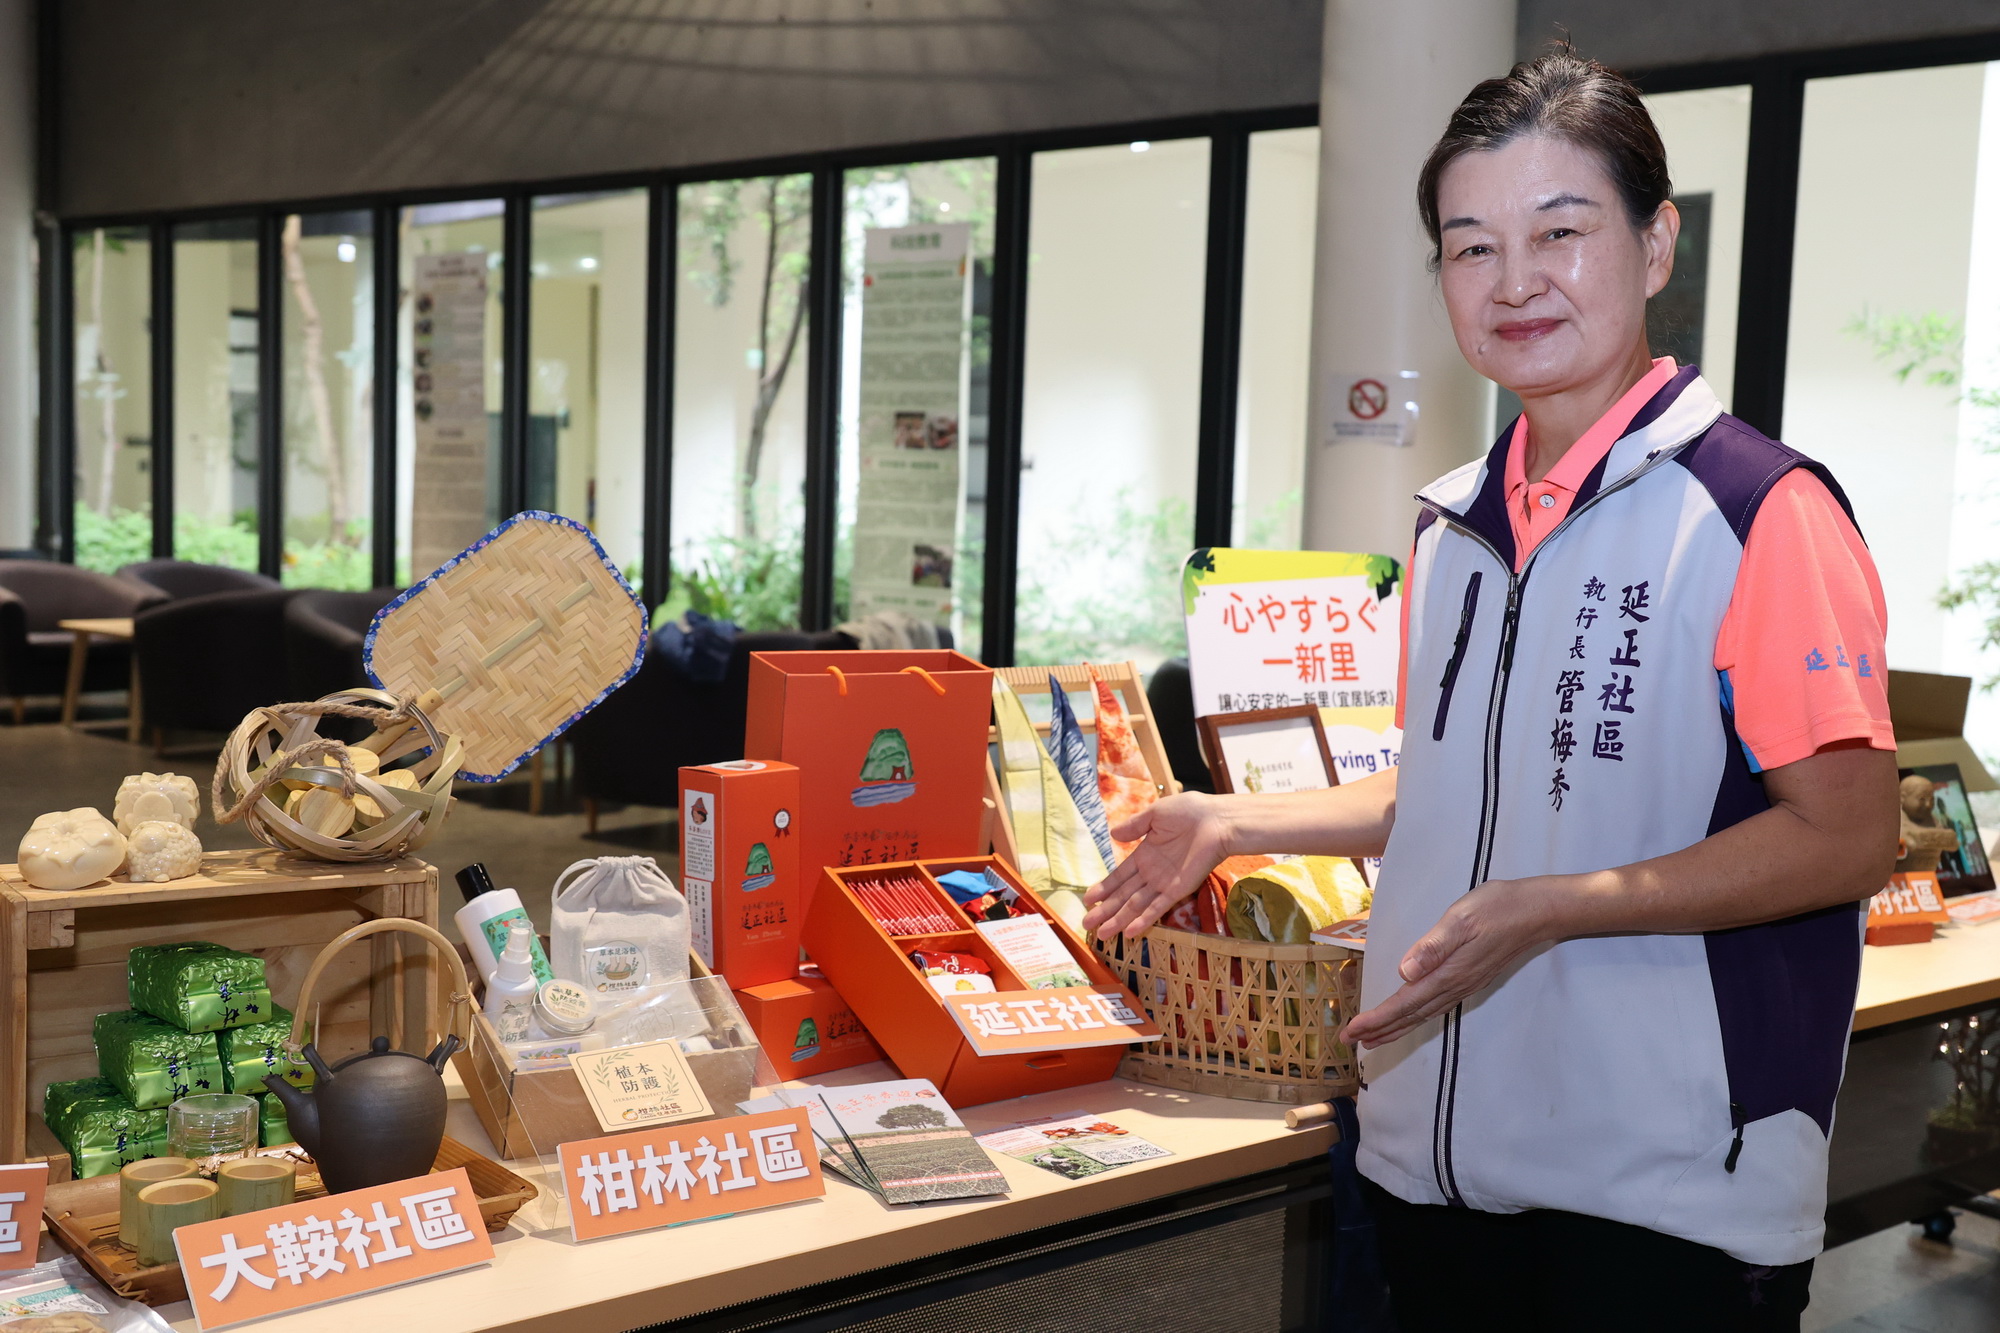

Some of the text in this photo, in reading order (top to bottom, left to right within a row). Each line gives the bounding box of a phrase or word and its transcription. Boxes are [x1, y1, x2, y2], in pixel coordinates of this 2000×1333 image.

[1222, 592, 1379, 635] 心やすらぐ
[1262, 641, 1360, 684] 一新里
[1591, 579, 1652, 763] 延正社區
[961, 993, 1146, 1038] 延正社區
[620, 1075, 662, 1093] 防護
[577, 1123, 810, 1218] 柑林社區
[200, 1186, 474, 1304] 大鞍社區
